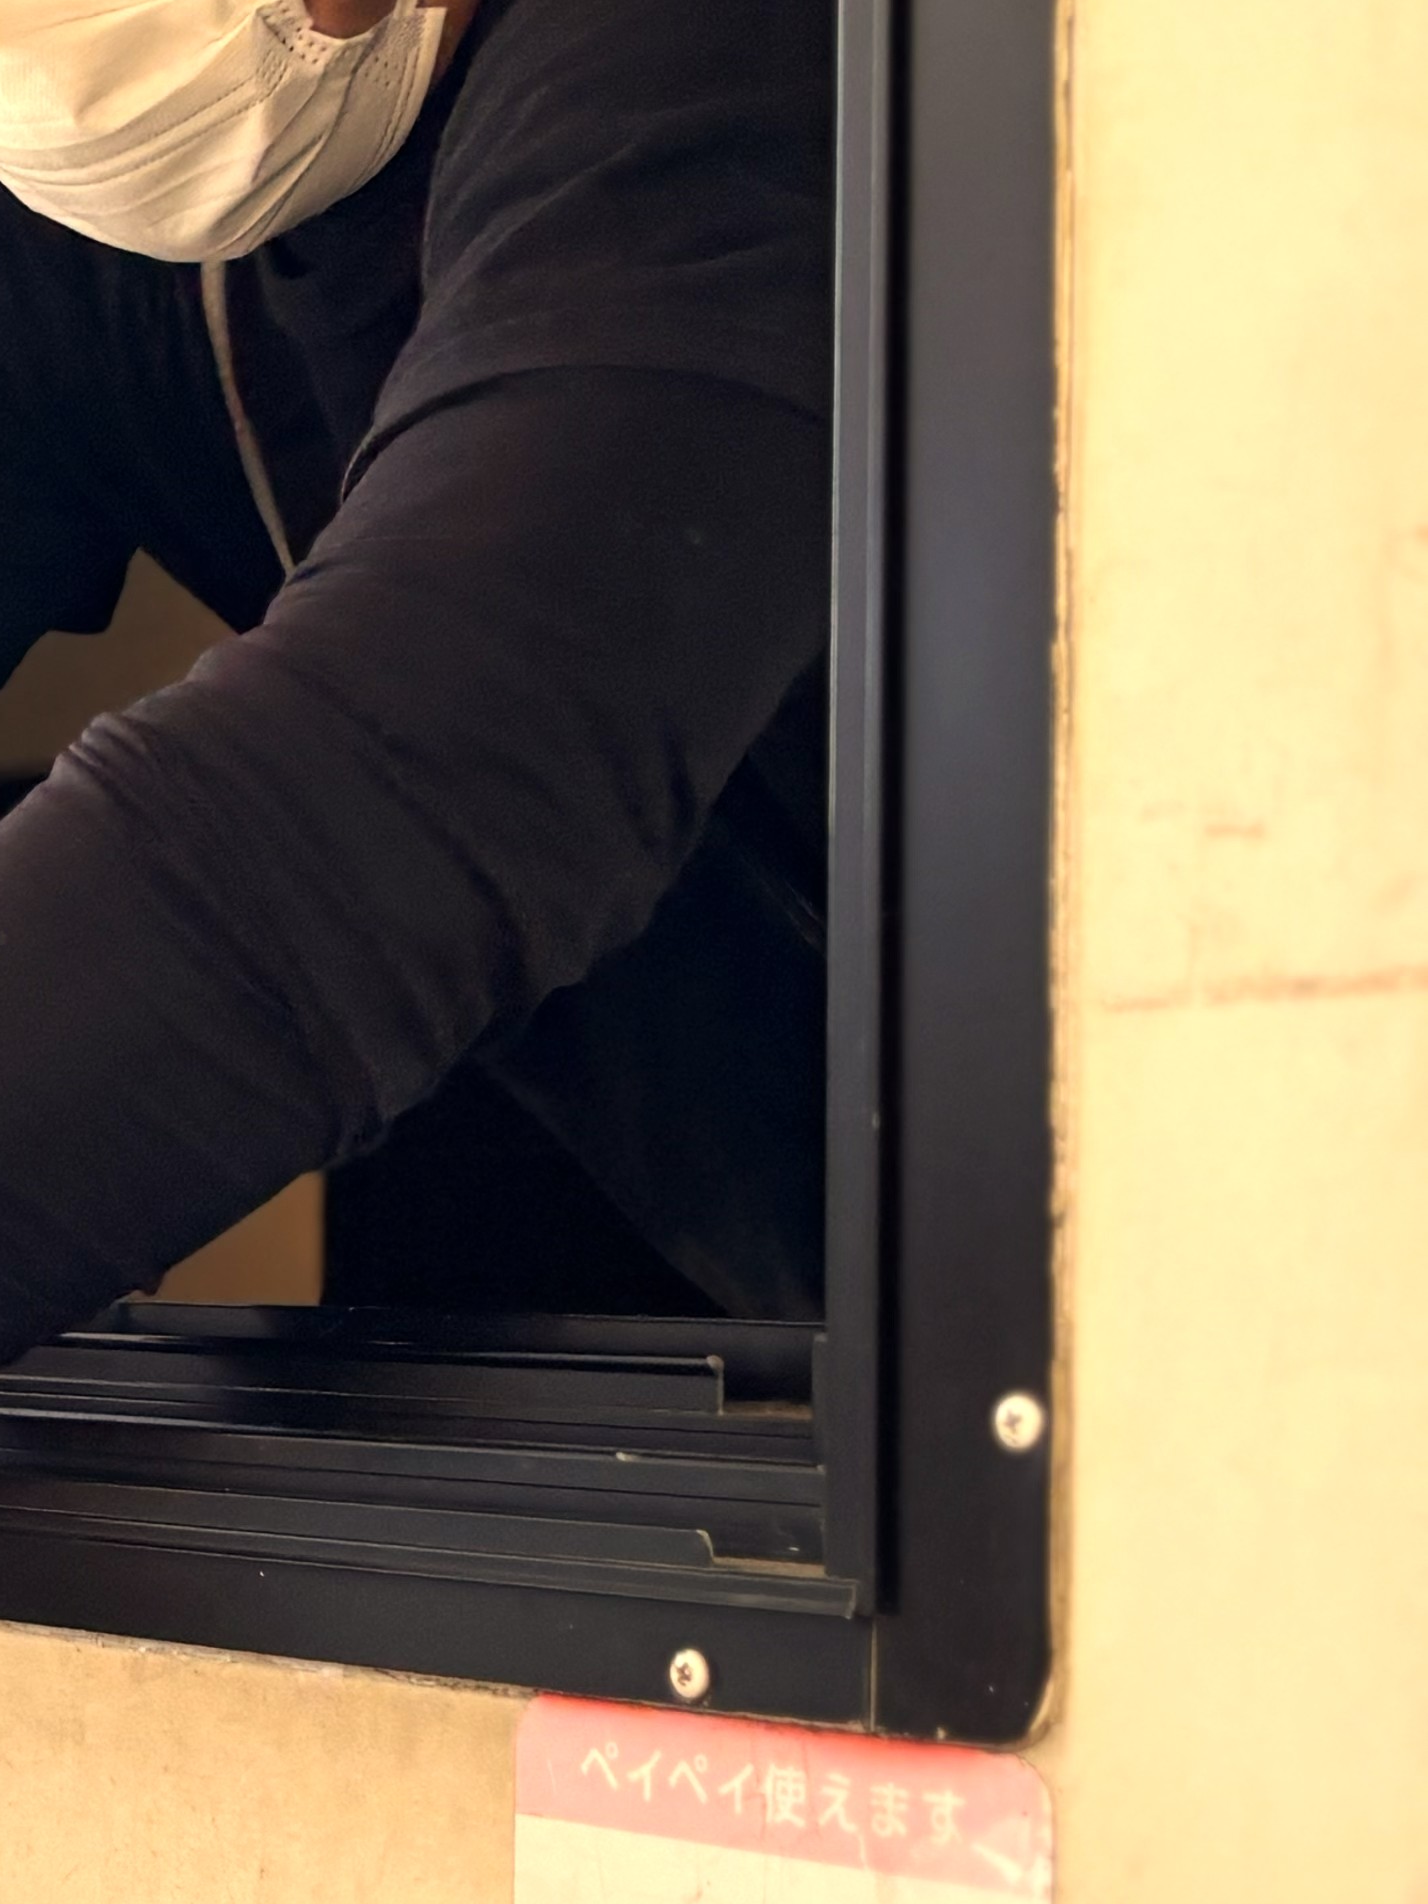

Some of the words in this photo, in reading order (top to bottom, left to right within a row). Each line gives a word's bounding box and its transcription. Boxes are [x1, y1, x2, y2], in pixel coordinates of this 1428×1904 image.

[581, 1741, 967, 1846] ペイペイ使えます
